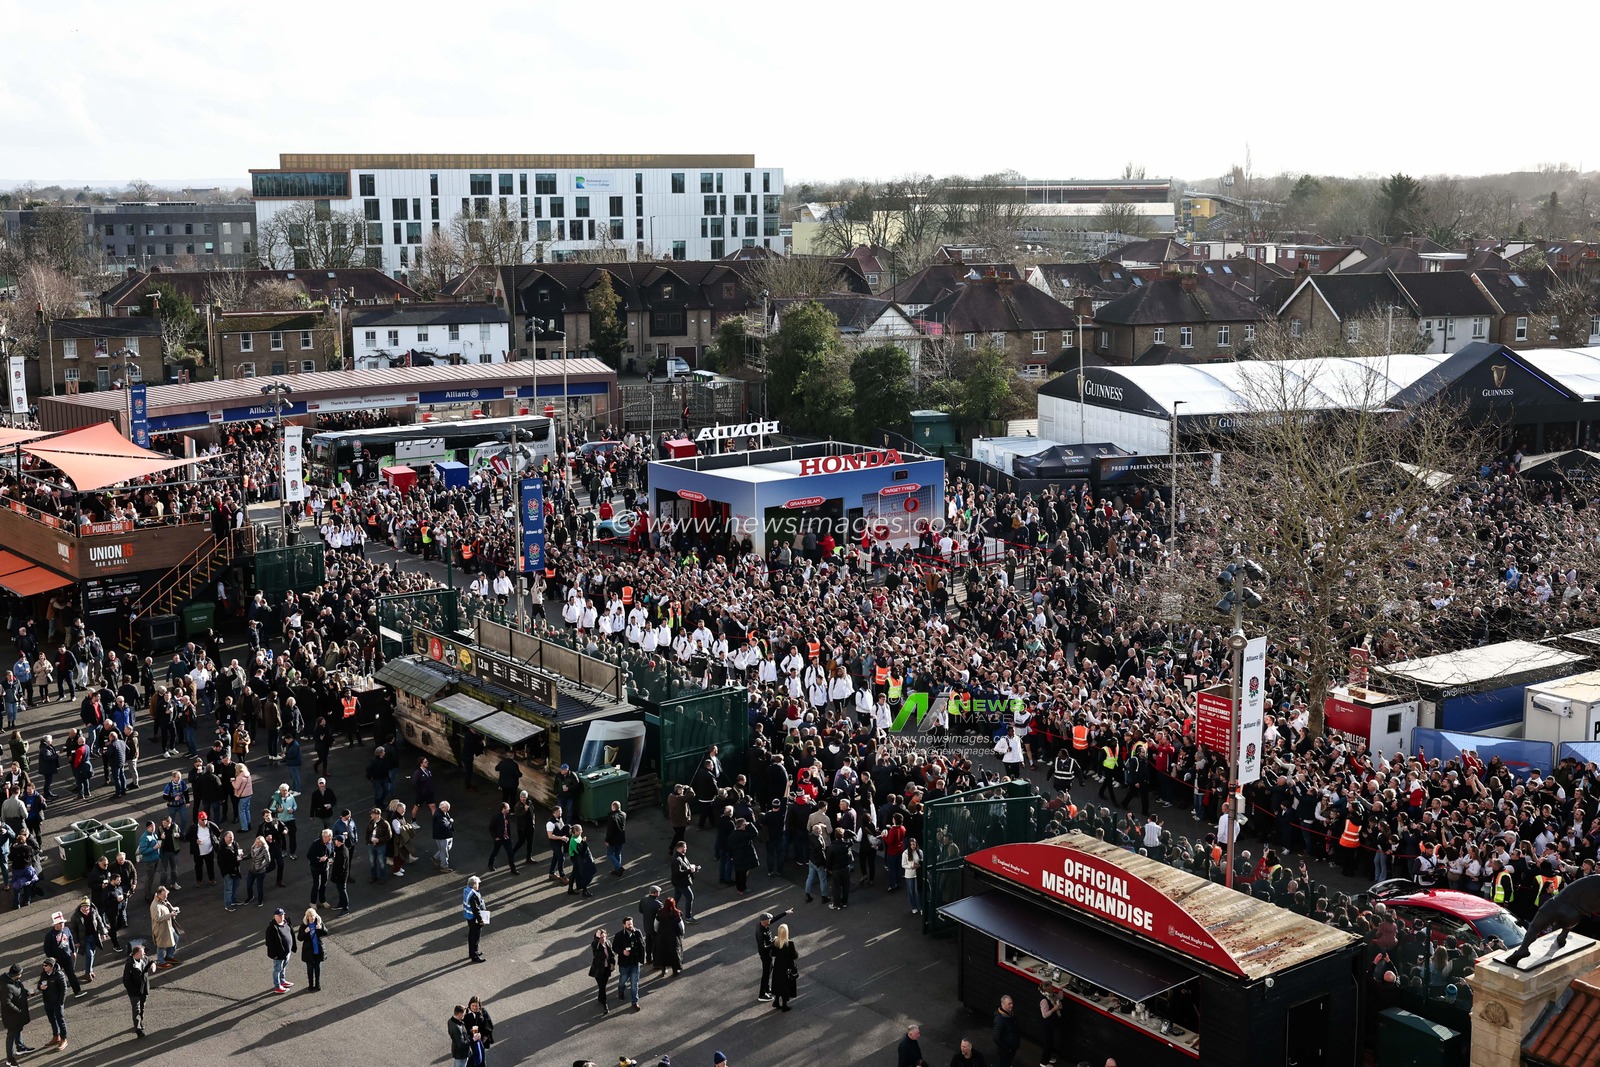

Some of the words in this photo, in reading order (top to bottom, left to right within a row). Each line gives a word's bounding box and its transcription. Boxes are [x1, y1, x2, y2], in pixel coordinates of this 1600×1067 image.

[1084, 380, 1124, 402] GUINNESS
[1482, 388, 1514, 396] GUINNESS
[799, 448, 904, 476] HONDA
[92, 524, 111, 533] PUBLIC
[112, 522, 123, 532] BAR
[90, 543, 134, 561] UNION15
[1246, 654, 1259, 662] Allianz
[1244, 721, 1256, 729] Allianz
[998, 858, 1010, 868] England
[1010, 863, 1020, 872] Rugby
[1064, 858, 1130, 900] OFFICIAL
[1042, 870, 1153, 932] MERCHANDISE
[1175, 930, 1190, 940] England
[1191, 935, 1203, 946] Rugby
[1203, 940, 1214, 949] Store
